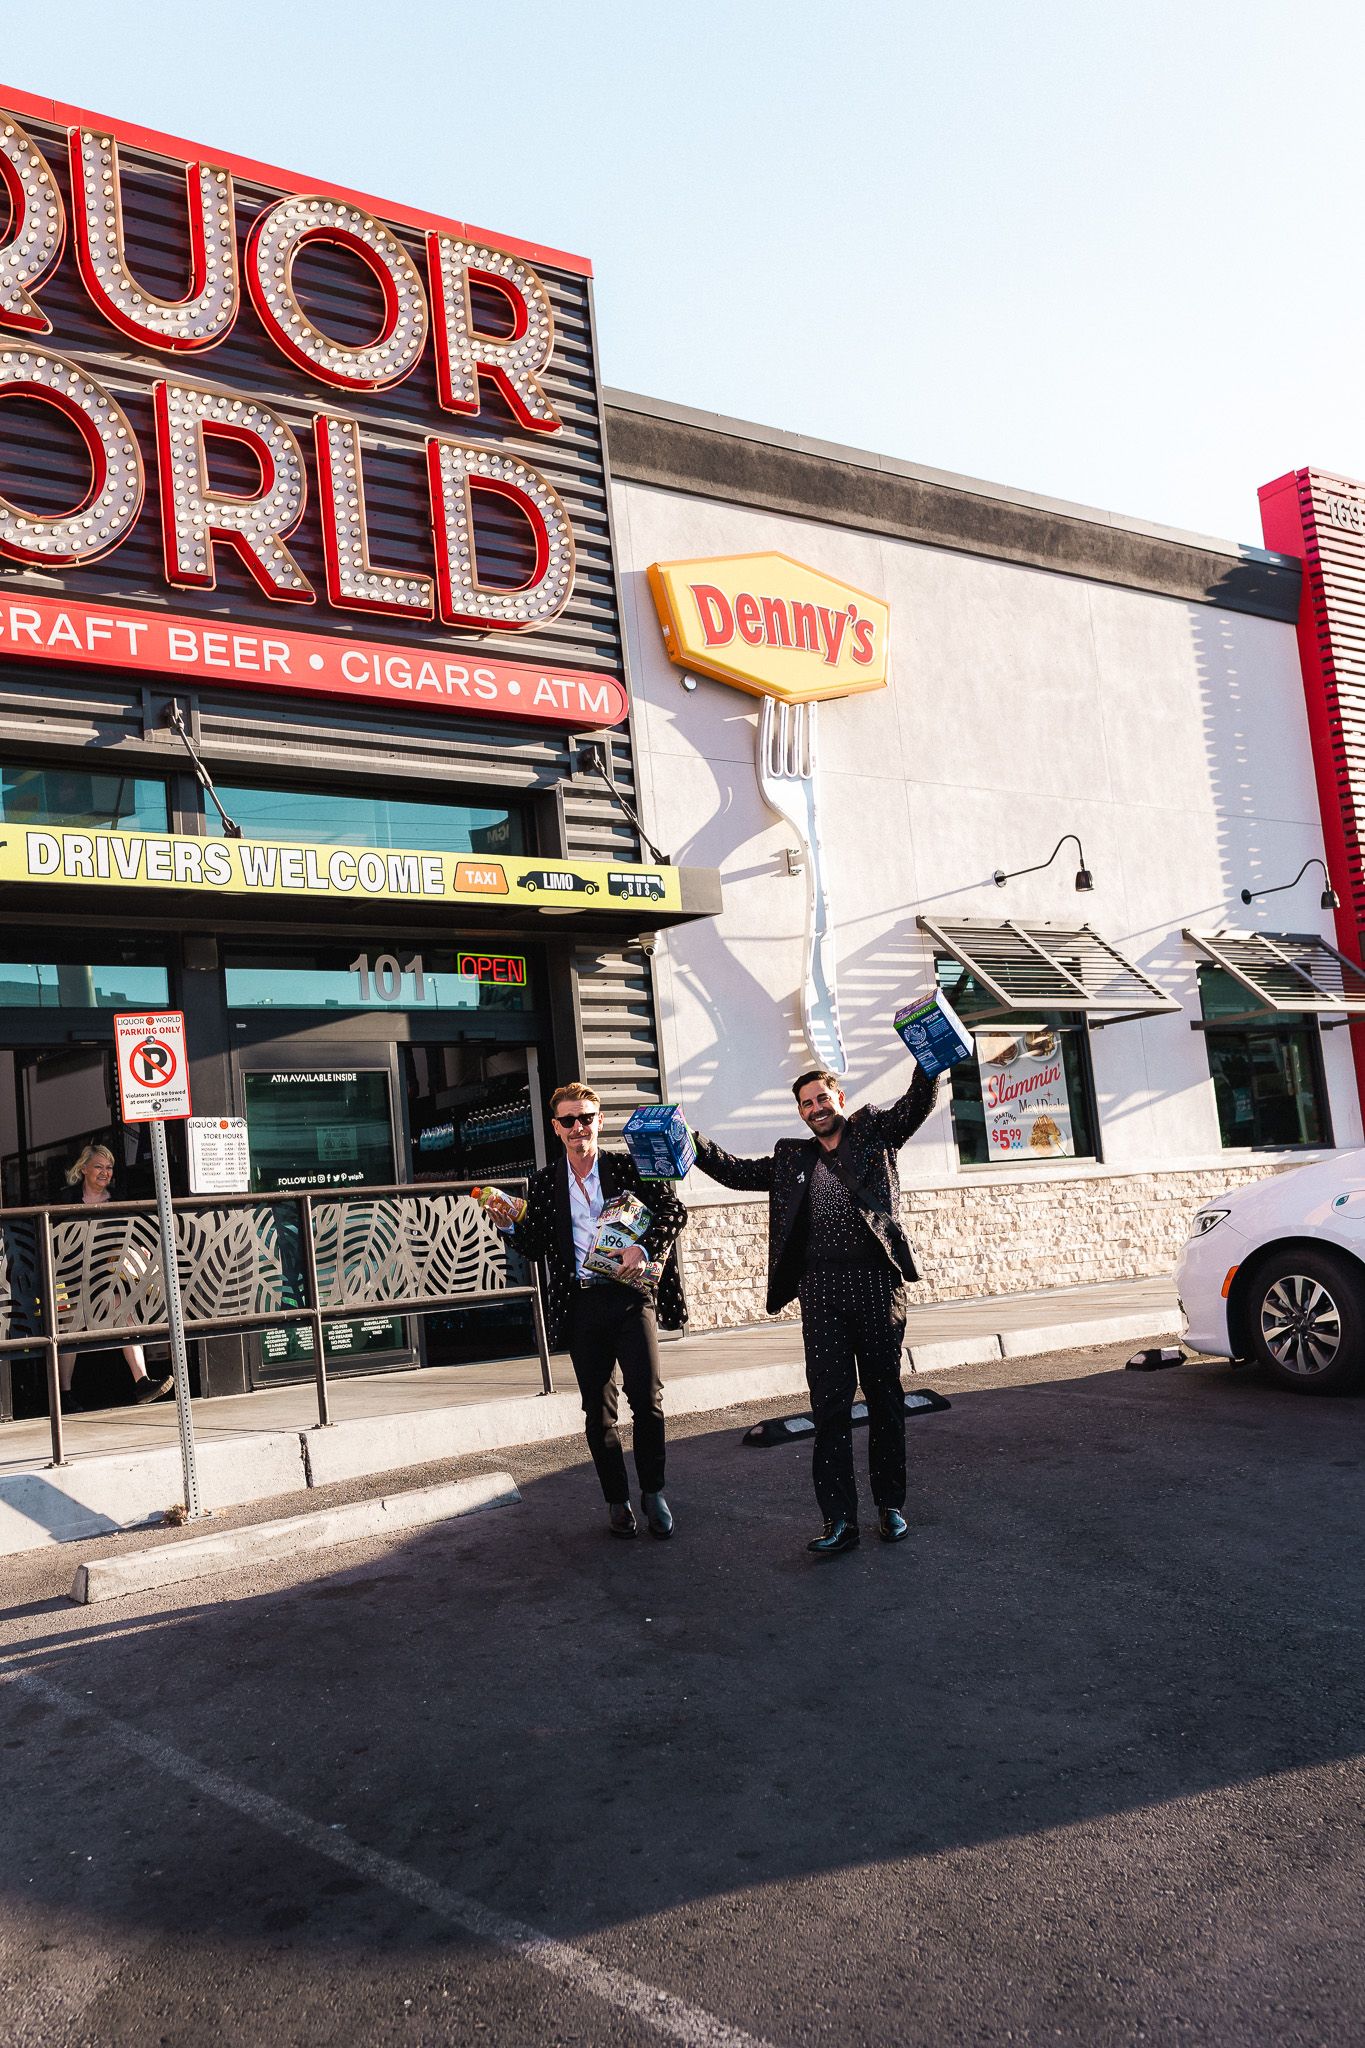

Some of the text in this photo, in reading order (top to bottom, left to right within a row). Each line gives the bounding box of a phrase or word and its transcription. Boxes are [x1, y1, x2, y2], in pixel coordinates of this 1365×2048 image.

[0, 343, 576, 634] ORLD
[688, 582, 876, 667] Denny's
[0, 605, 610, 714] RAFT BEER CIGARS ATM
[25, 831, 446, 895] DRIVERS WELCOME
[465, 870, 497, 885] TAXI
[543, 872, 574, 890] LIMO
[628, 882, 651, 896] BUS
[349, 953, 426, 1001] 101
[461, 955, 523, 983] OPEN
[117, 1018, 145, 1026] LIQUOR
[120, 1026, 180, 1036] PARKING ONLY
[271, 1073, 357, 1083] ATM AVAILABLE INSIDE
[987, 1063, 1061, 1109] Slammin'
[189, 1121, 217, 1129] LIQUOR
[993, 1112, 1017, 1124] STARTING
[278, 1177, 306, 1186] FOLLOW
[307, 1175, 317, 1184] US
